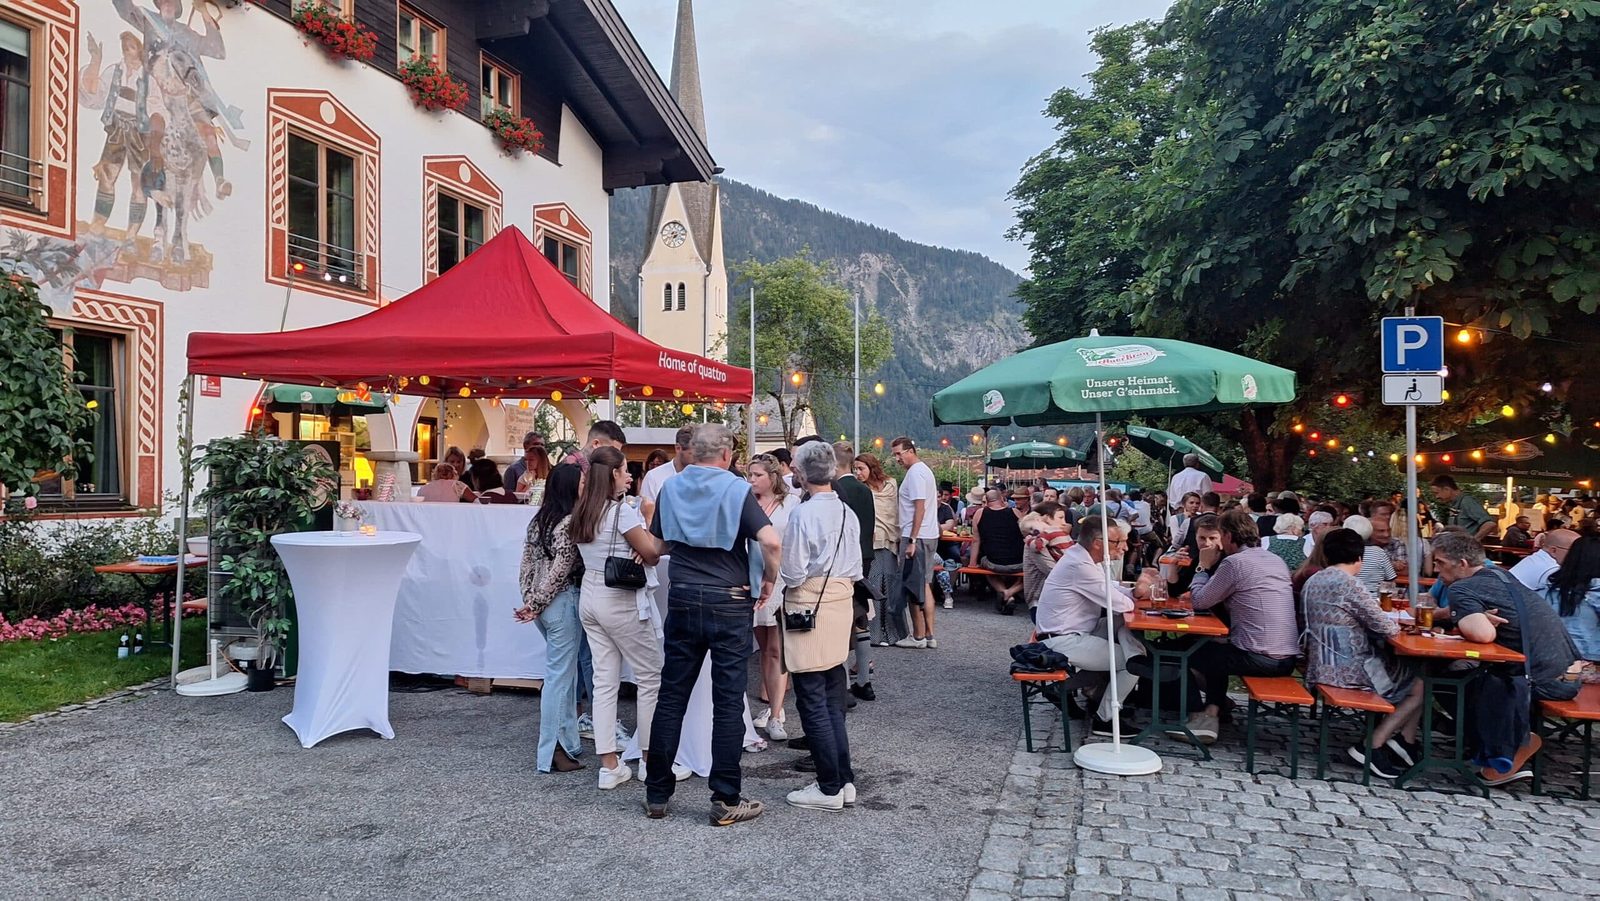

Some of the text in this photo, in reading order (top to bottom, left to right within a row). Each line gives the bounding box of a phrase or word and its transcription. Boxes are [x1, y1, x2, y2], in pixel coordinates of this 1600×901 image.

[1397, 324, 1429, 365] P
[658, 351, 727, 382] Home of quattro
[1081, 384, 1180, 399] Unser G'schmack.
[1086, 376, 1172, 388] Unsere Heimat.
